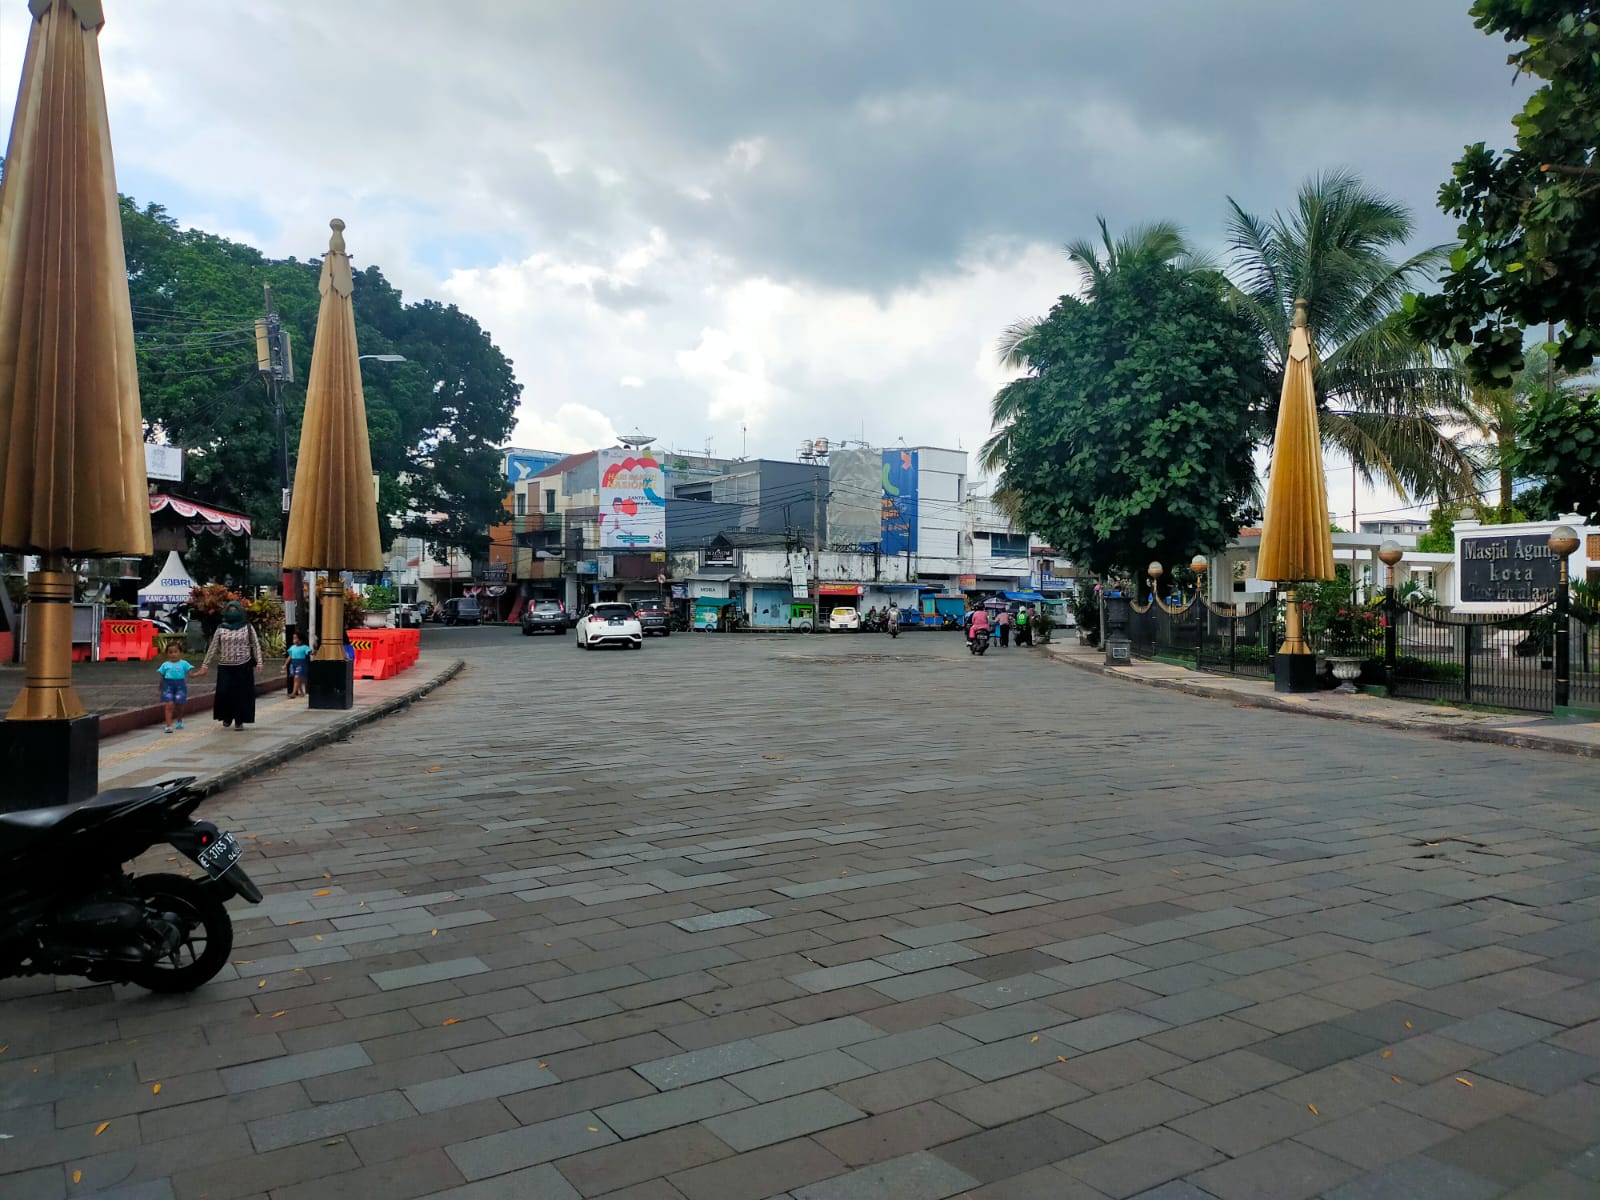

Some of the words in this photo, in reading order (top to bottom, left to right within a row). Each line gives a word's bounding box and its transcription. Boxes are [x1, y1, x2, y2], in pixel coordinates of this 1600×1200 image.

[1465, 539, 1509, 561] Masjid
[145, 594, 167, 602] KANCA
[209, 841, 227, 859] 3765
